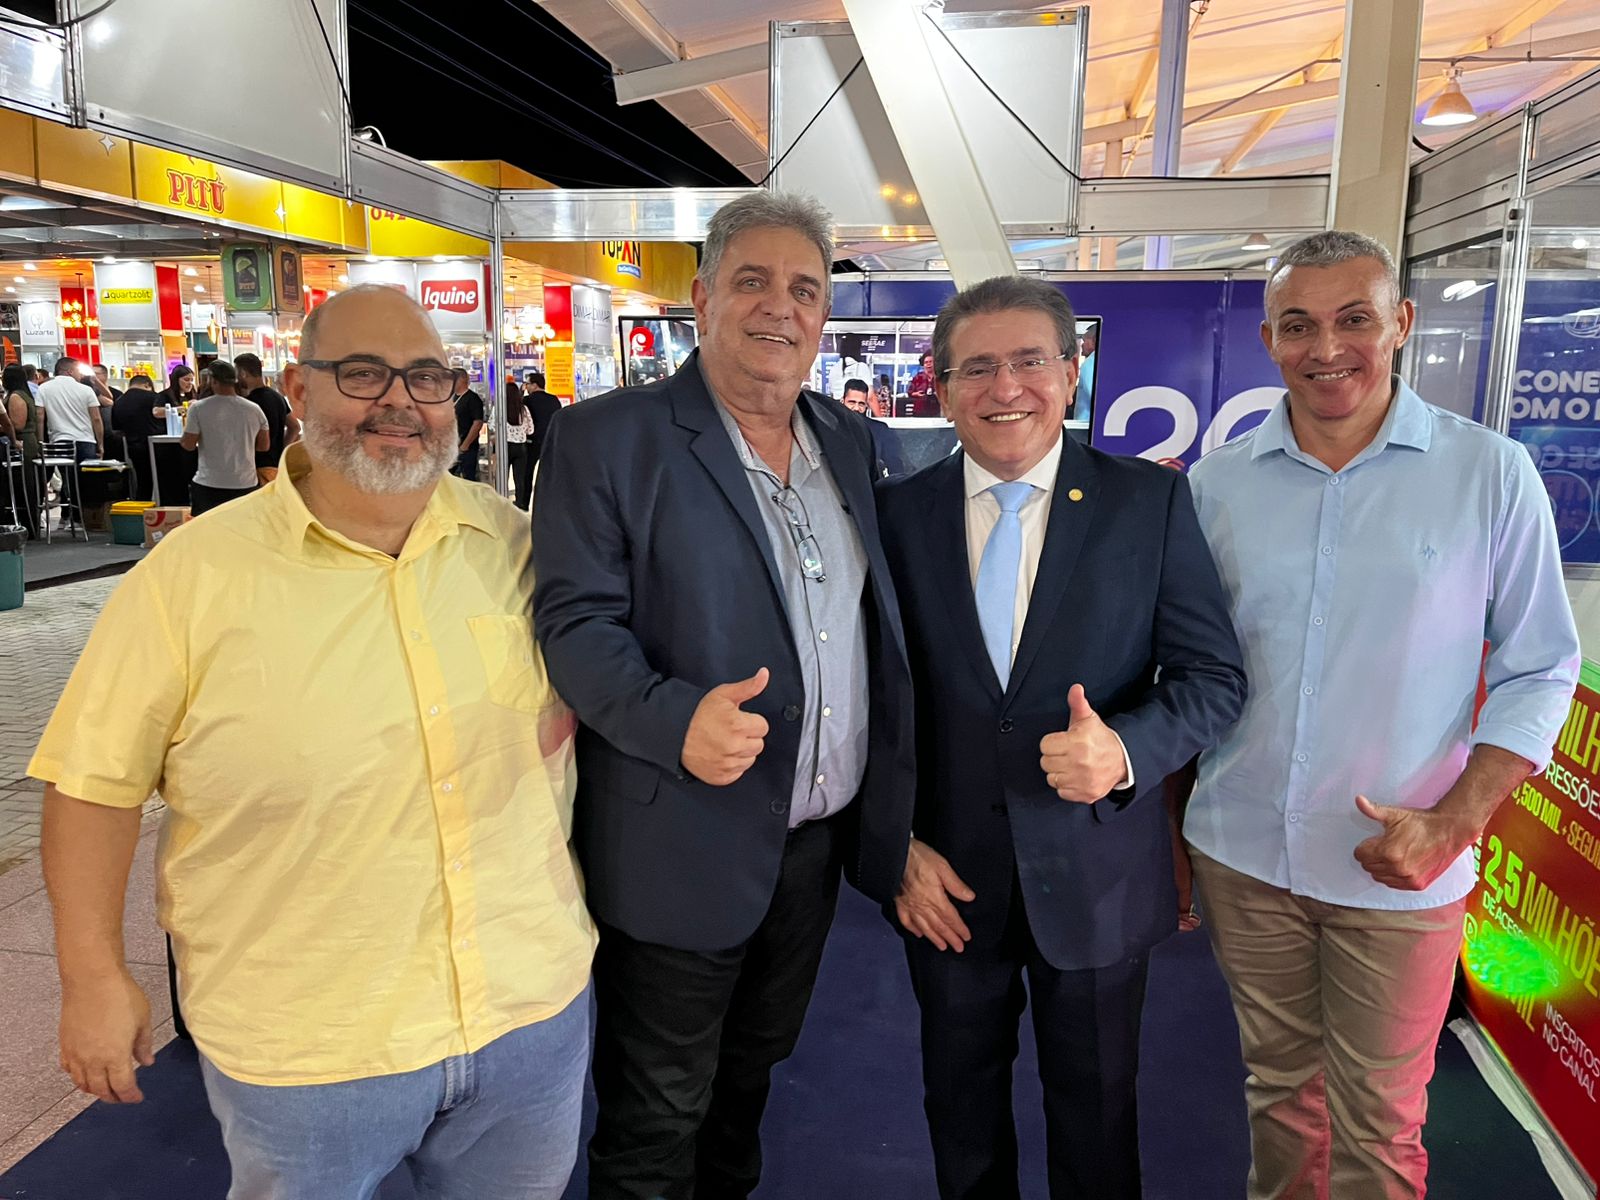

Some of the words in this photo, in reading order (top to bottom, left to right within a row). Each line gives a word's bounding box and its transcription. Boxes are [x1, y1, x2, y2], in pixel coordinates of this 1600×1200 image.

[167, 170, 225, 213] PITÚ
[110, 288, 151, 300] quartzolit
[424, 287, 476, 309] Iquine
[1513, 369, 1600, 394] CONE
[1564, 397, 1591, 420] O
[1540, 797, 1562, 835] MIL
[1482, 890, 1496, 918] DE
[1546, 1001, 1600, 1077] INSCRITOS
[1542, 1022, 1559, 1053] NO
[1560, 1045, 1597, 1103] CANAL
